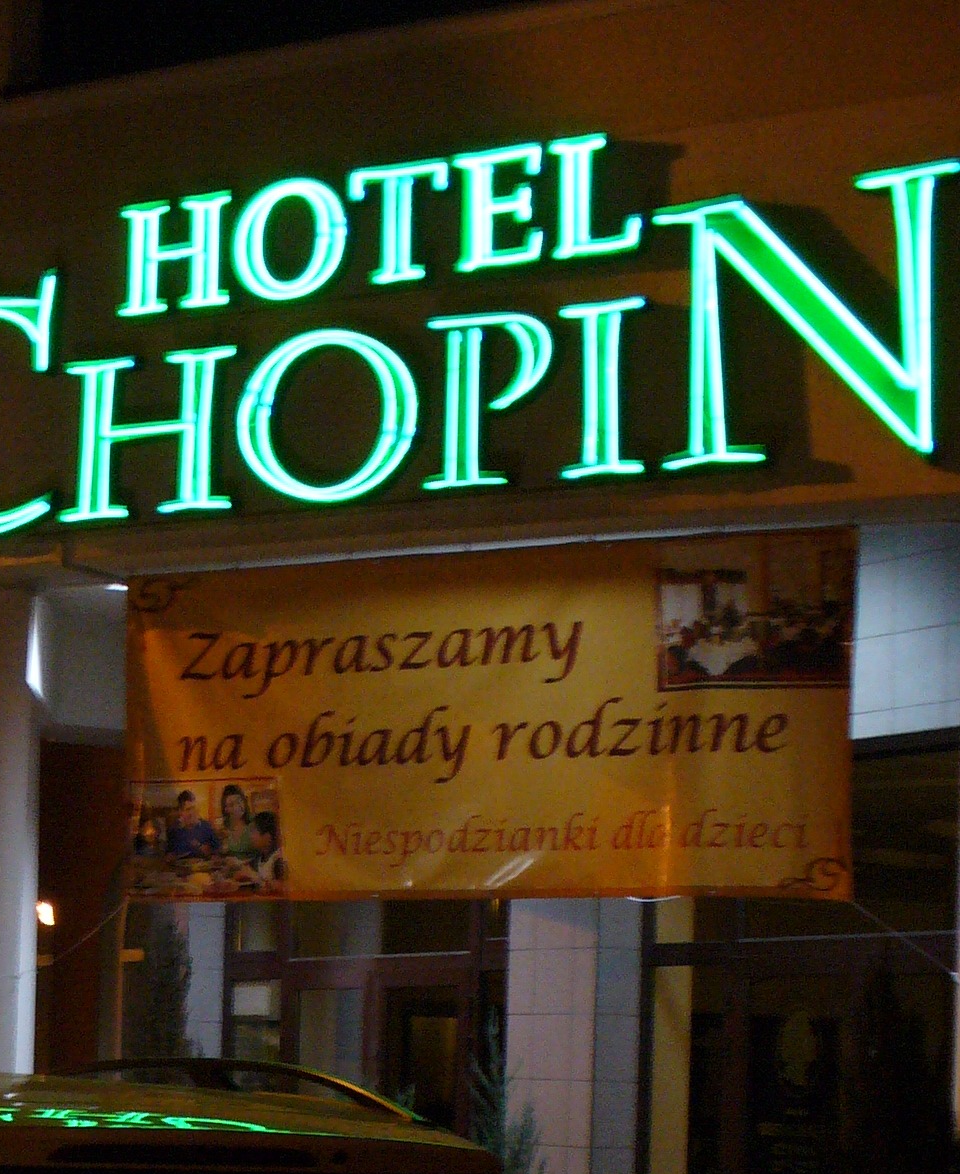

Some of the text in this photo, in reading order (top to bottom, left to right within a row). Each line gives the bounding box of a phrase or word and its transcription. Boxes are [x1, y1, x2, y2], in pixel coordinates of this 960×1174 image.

[116, 131, 644, 320] HOTEL
[180, 619, 584, 697] Zapraszamy
[179, 697, 789, 783] na obiady rodzinne
[315, 812, 599, 868] Niespodzianki
[678, 808, 809, 852] dzieci
